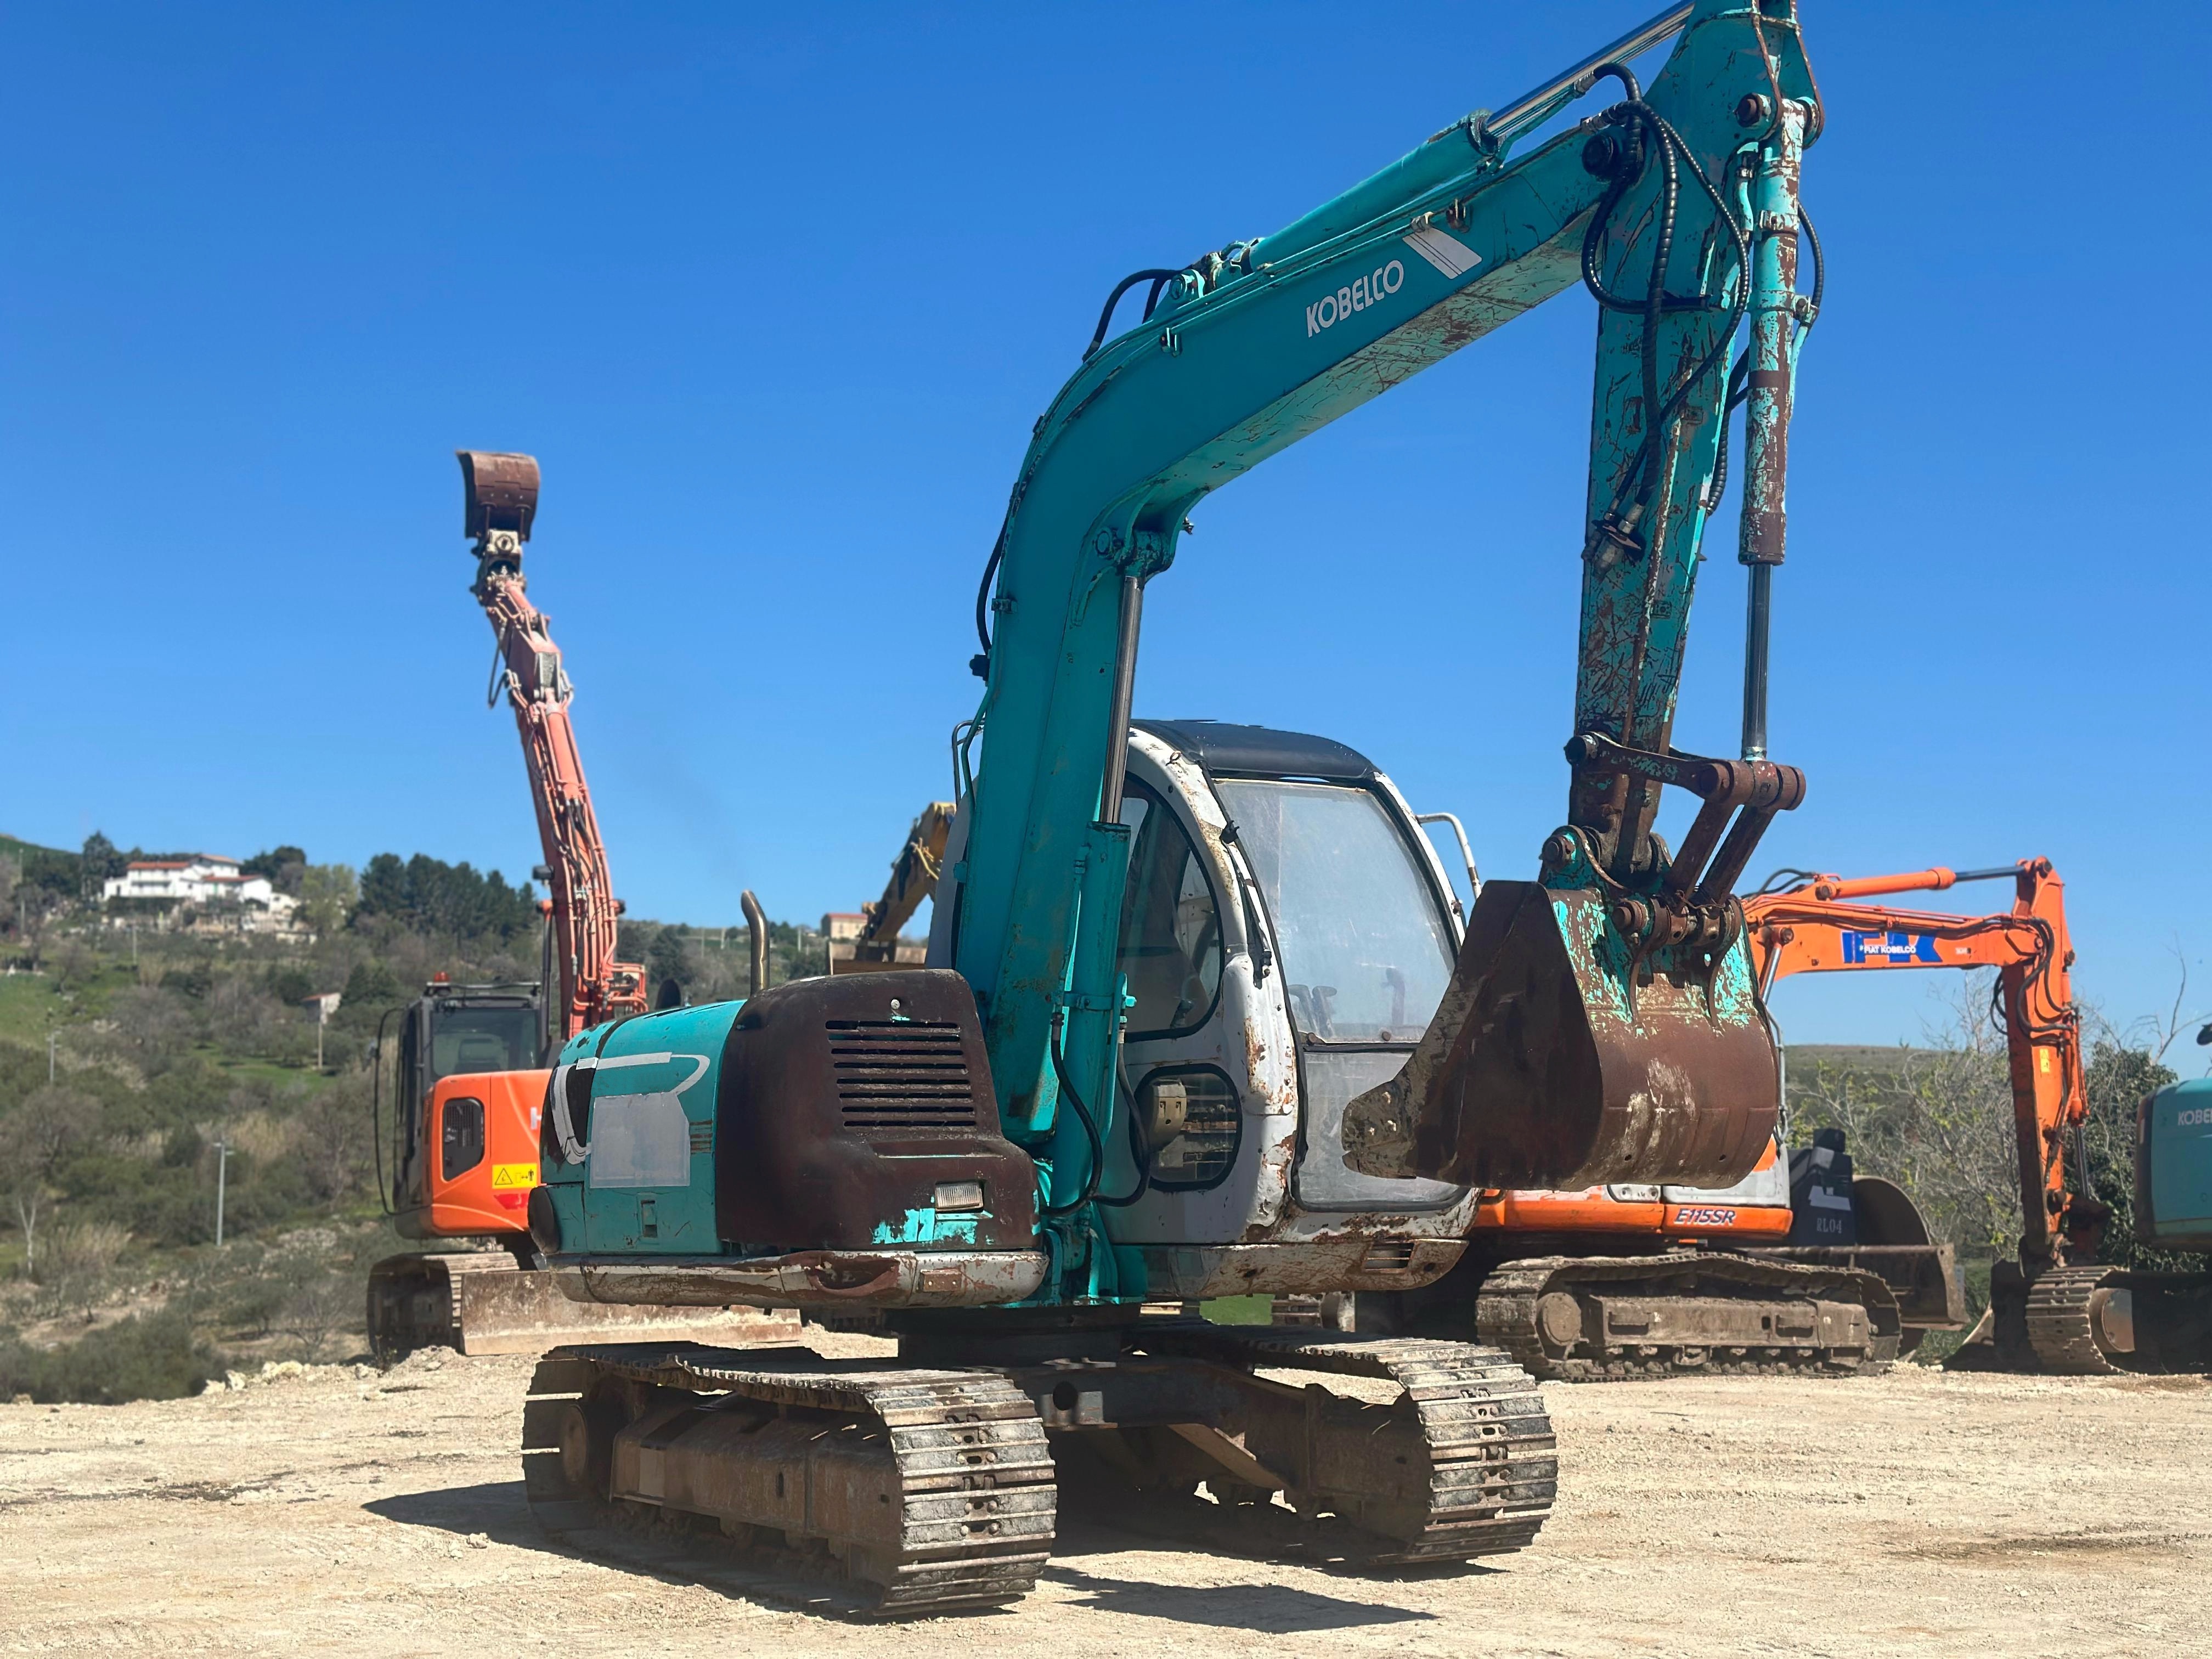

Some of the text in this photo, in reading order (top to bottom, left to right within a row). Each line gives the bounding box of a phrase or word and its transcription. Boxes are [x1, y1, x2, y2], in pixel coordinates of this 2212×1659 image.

[1306, 259, 1404, 338] KOBELCO
[1864, 945, 1916, 954] FIAT KOBELCO
[2178, 1108, 2212, 1126] KOBE
[1674, 1208, 1737, 1226] E115SR
